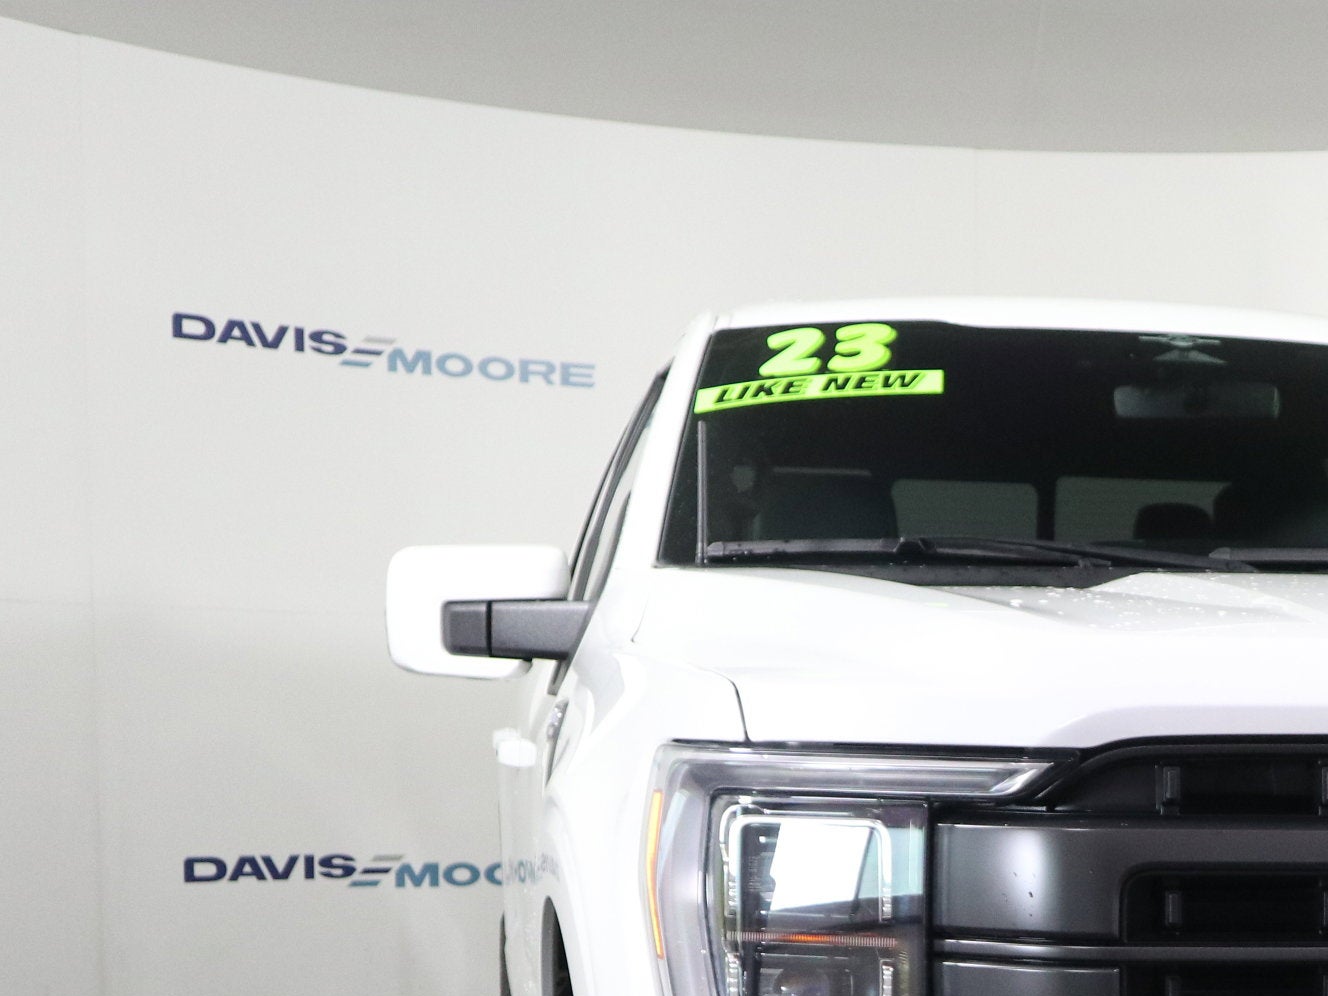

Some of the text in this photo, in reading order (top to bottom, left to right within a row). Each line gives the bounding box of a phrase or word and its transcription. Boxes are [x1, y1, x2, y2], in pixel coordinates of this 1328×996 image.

[172, 312, 597, 388] DAVIS MOORE
[758, 322, 898, 378] 23
[713, 372, 924, 404] LIKE NEW
[183, 853, 357, 883] DAVIS
